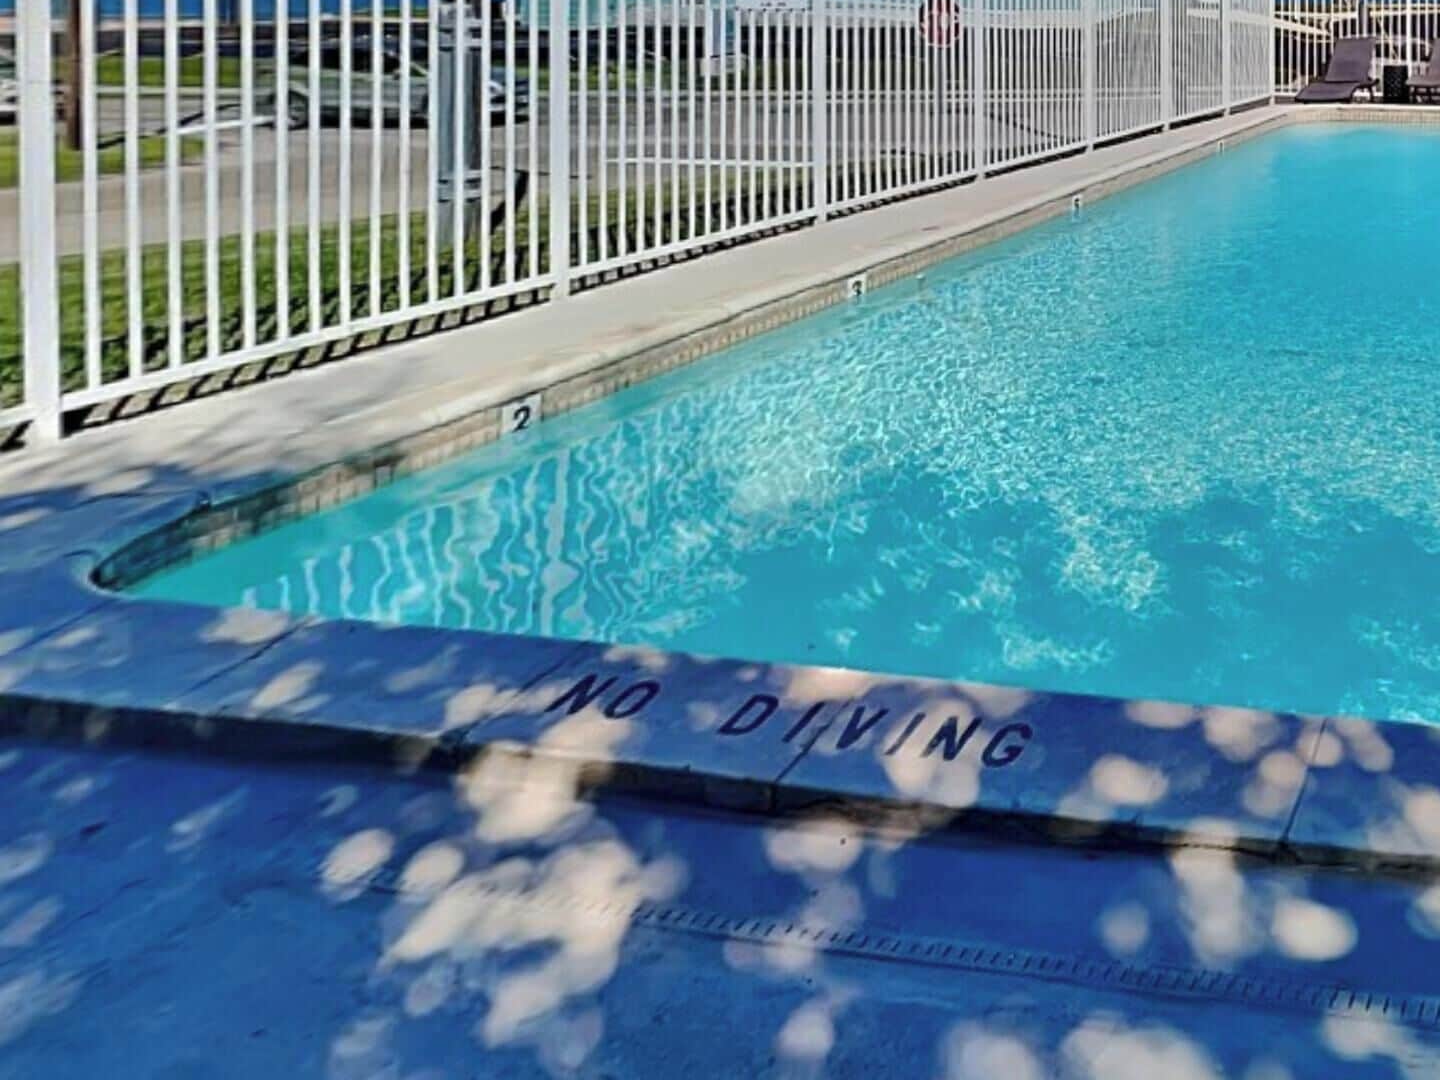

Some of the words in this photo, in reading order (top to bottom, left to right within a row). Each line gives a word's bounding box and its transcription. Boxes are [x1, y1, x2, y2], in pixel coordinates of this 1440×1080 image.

[512, 405, 530, 433] 2
[543, 673, 661, 720] NO
[715, 693, 1034, 769] DIVING
